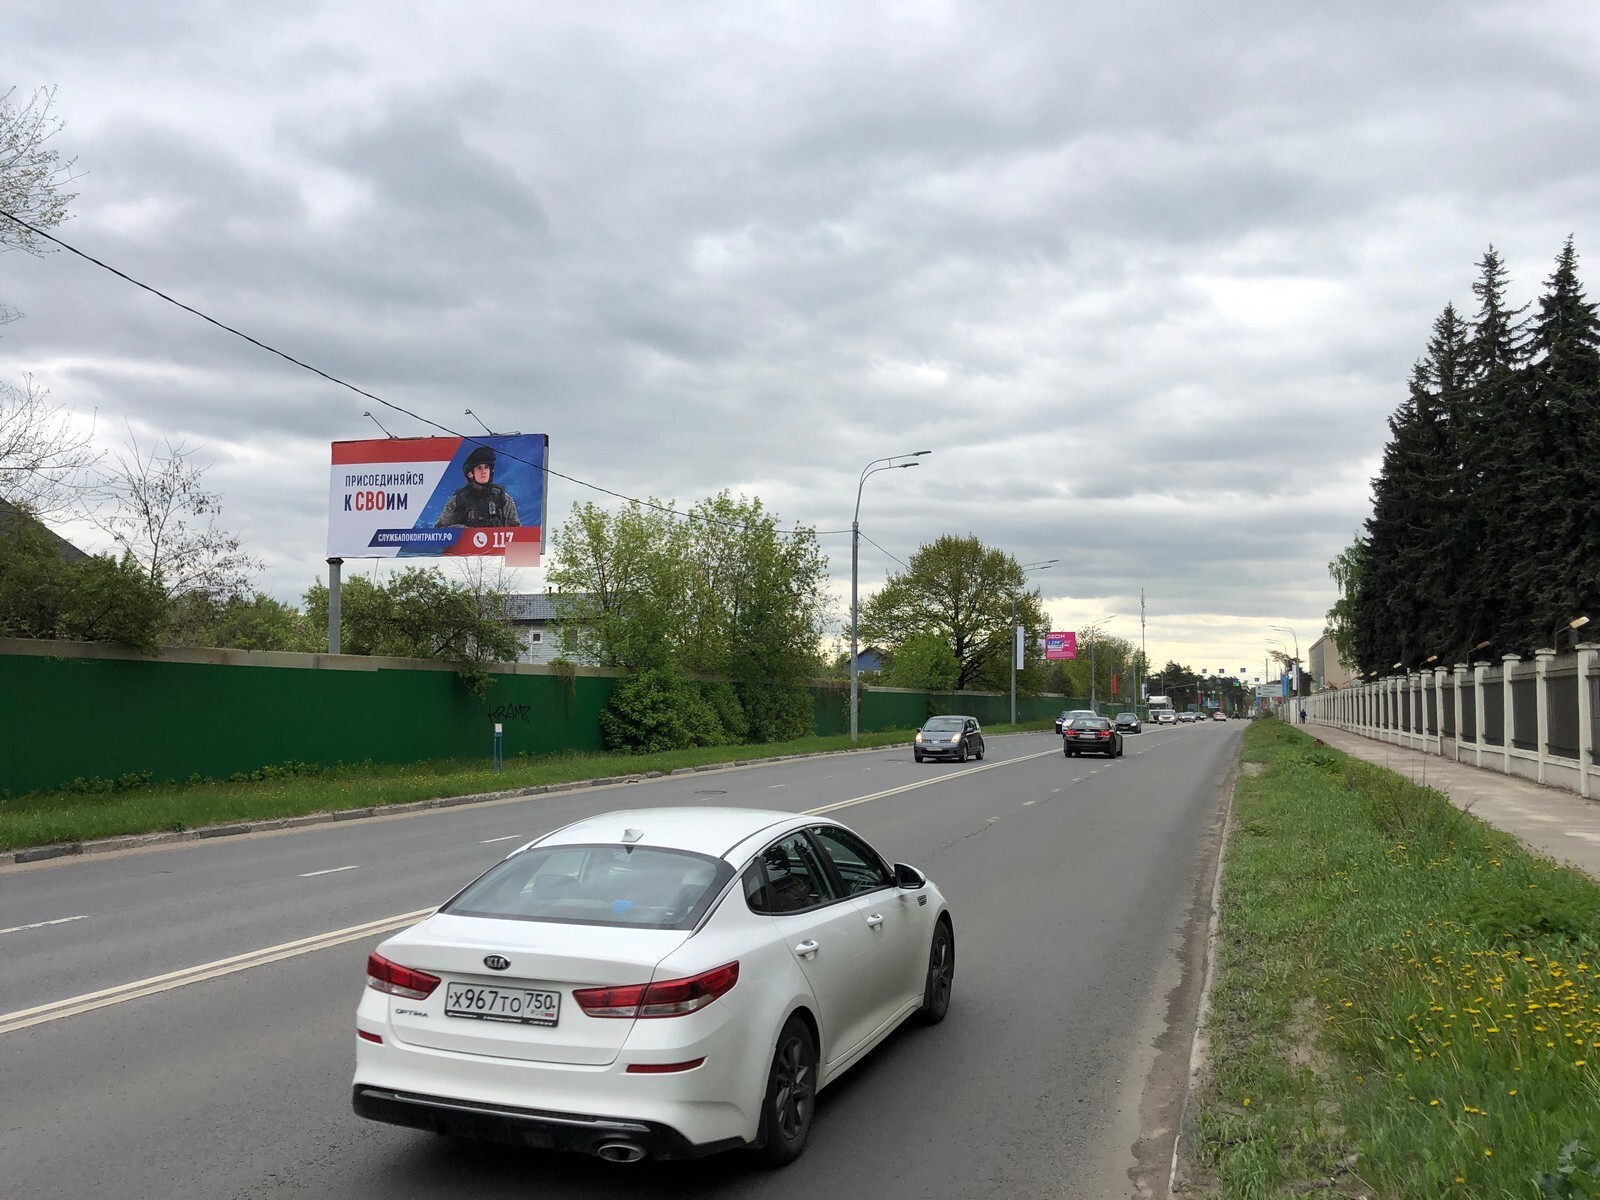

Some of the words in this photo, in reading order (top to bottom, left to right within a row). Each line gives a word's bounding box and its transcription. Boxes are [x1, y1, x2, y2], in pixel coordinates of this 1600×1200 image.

[345, 471, 424, 487] ПРИСОЕДИНЯЙСЯ
[344, 494, 352, 511] К
[378, 533, 453, 542] СЛУЖБАПОКОНТРАКТУ.РФ
[486, 956, 507, 969] KIA
[526, 992, 553, 1010] 750
